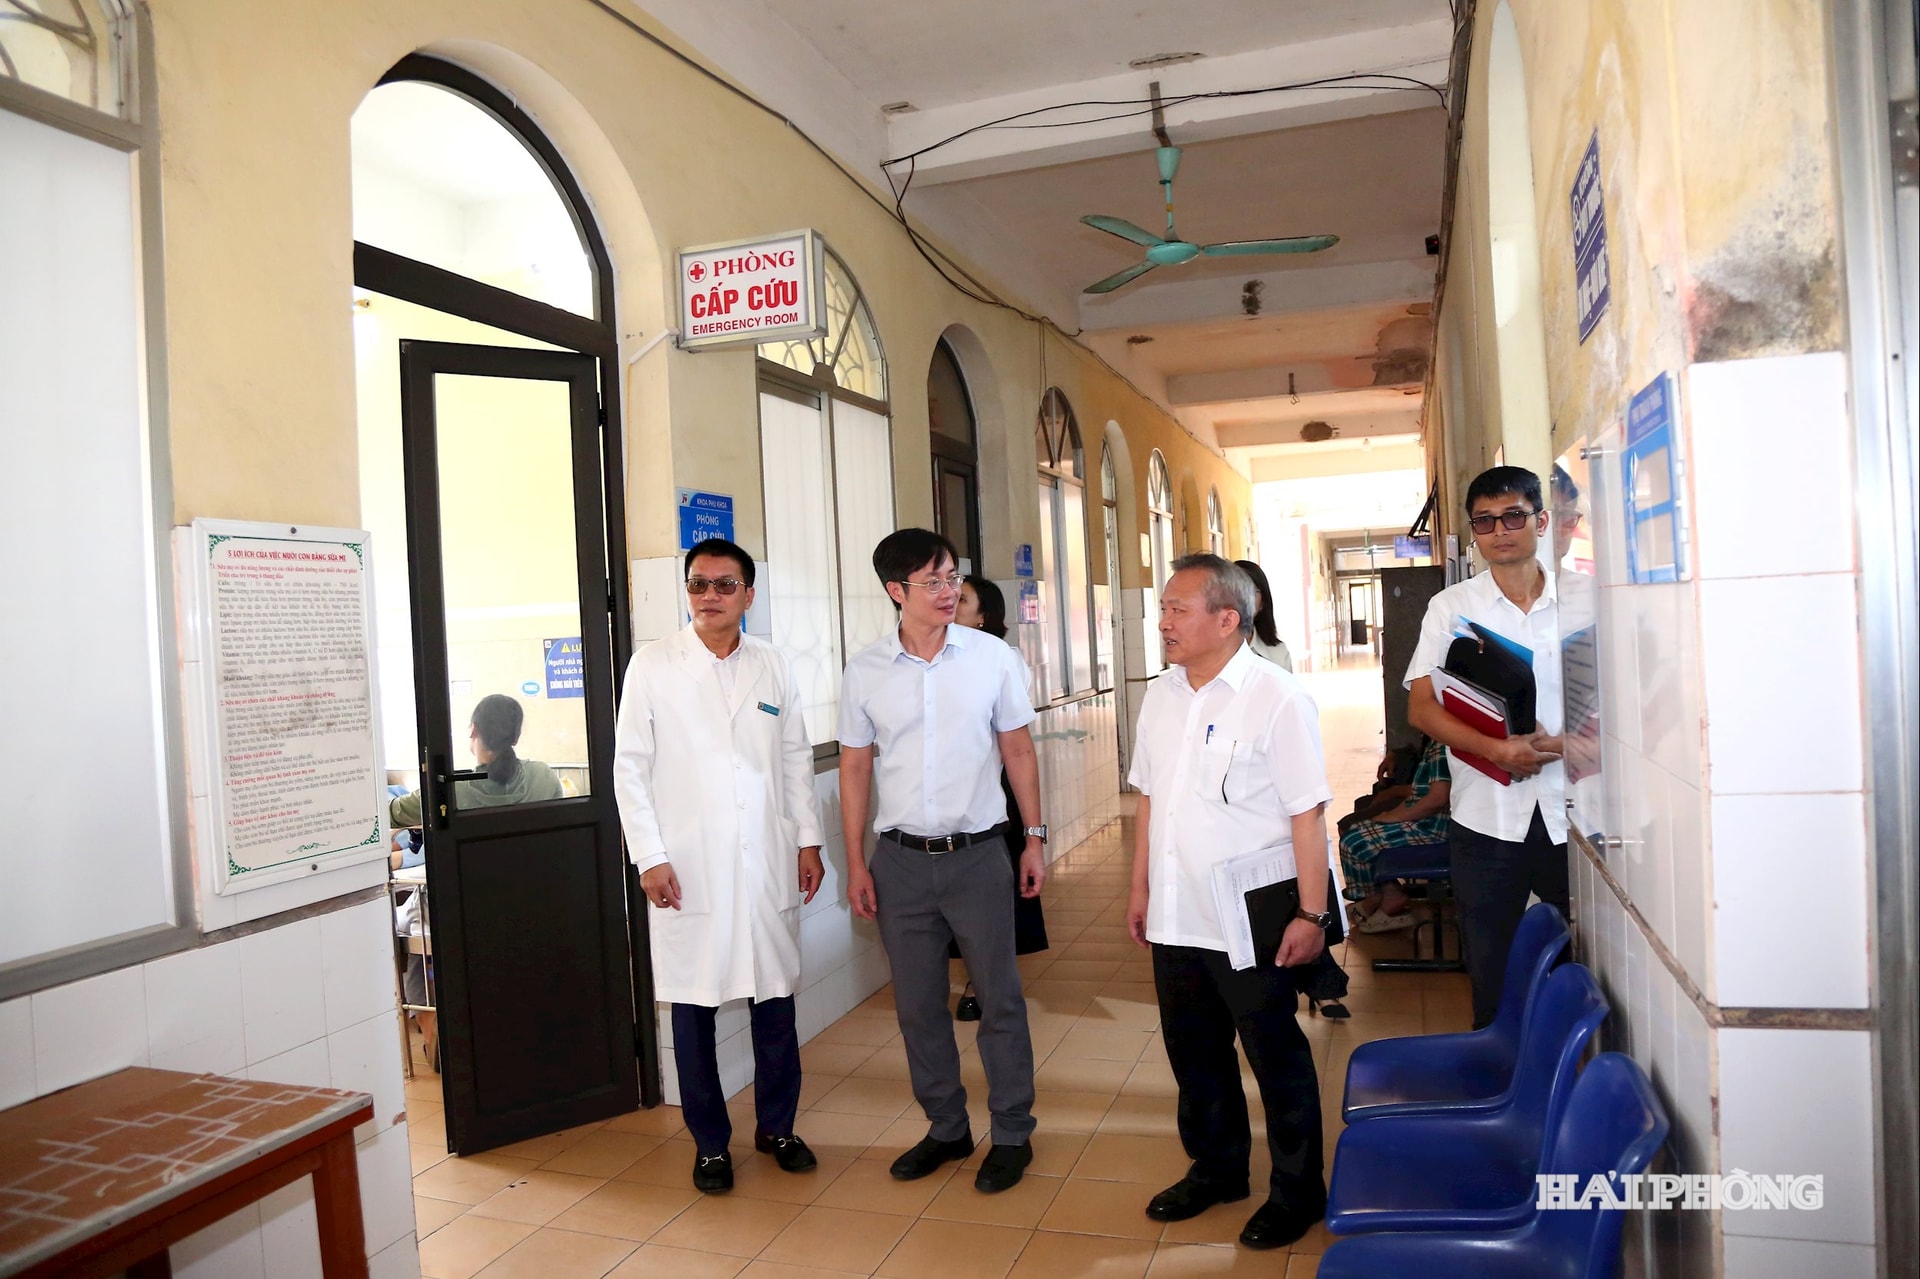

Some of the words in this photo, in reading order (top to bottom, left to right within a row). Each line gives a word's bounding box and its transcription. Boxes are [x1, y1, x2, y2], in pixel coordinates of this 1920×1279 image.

[713, 250, 795, 277] PHÒNG
[691, 282, 739, 318] CẤP
[747, 278, 798, 310] CỨU
[692, 317, 761, 335] EMERGENCY
[765, 312, 798, 326] ROOM
[696, 513, 719, 526] PHÒNG
[692, 526, 708, 543] CẤP
[298, 552, 311, 560] CON
